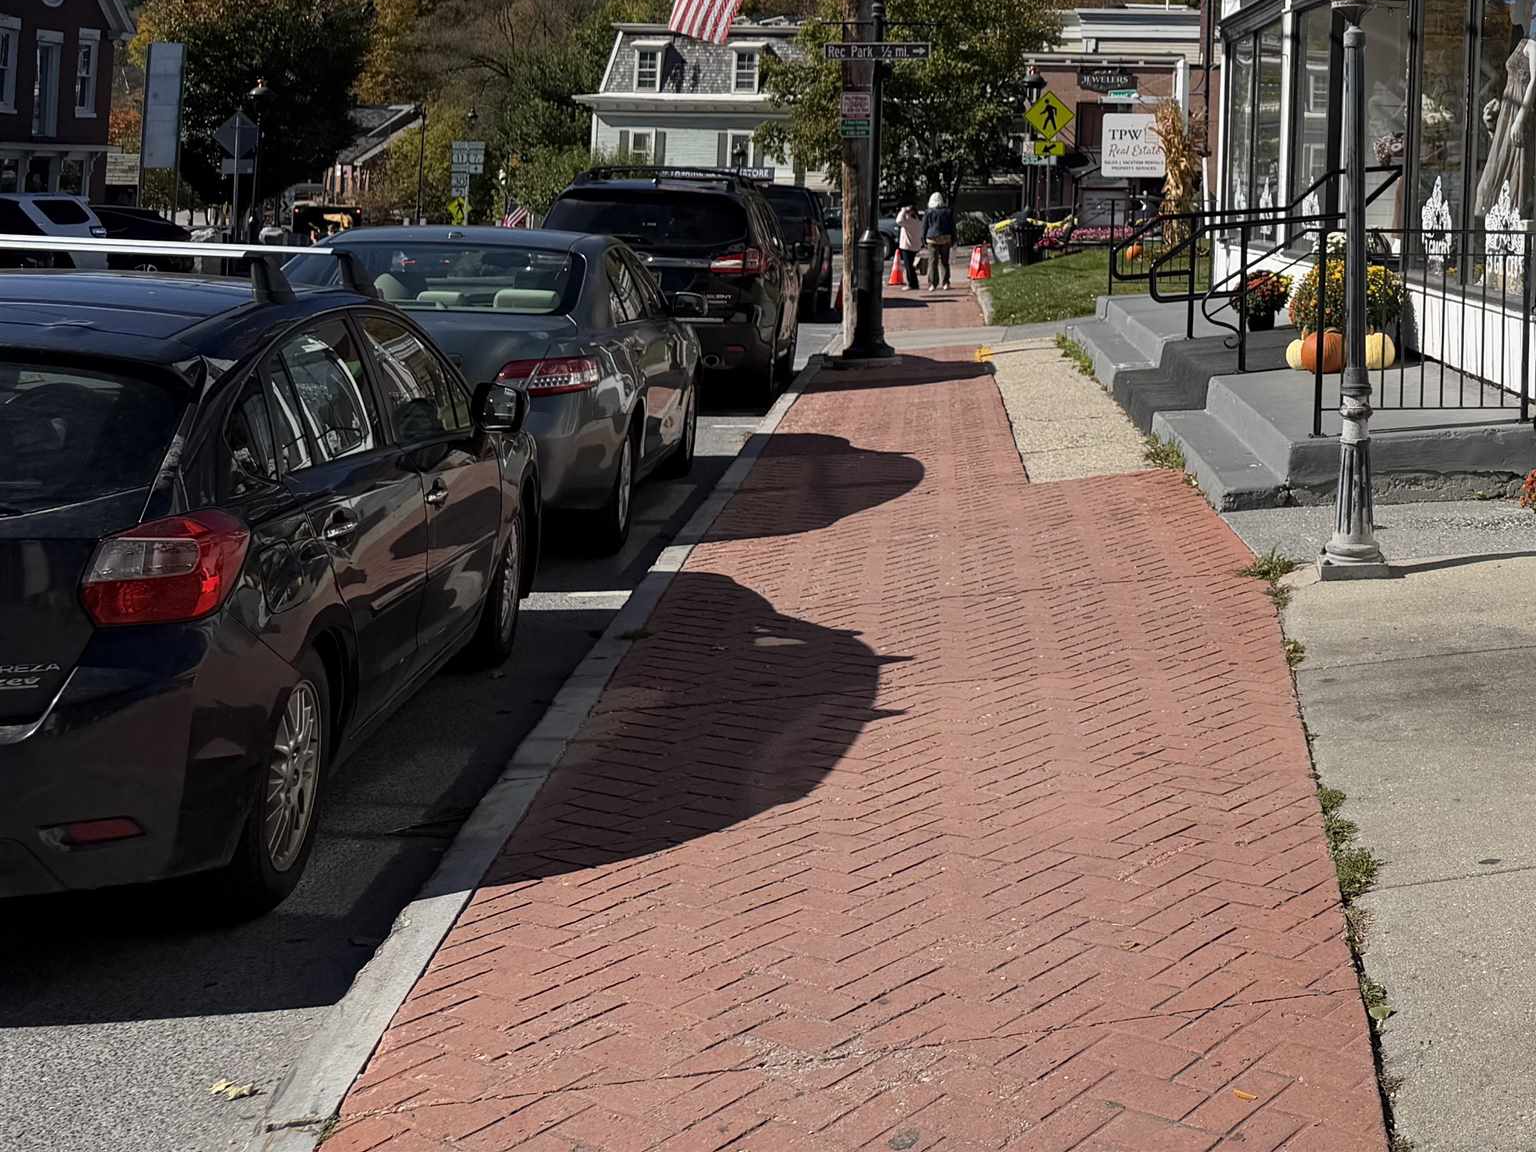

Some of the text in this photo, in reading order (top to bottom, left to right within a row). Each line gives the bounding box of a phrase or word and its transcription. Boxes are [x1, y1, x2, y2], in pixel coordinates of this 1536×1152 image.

[827, 45, 846, 58] Rec
[850, 45, 873, 58] Park
[1108, 129, 1142, 141] TPW
[1108, 144, 1161, 158] Real Estate
